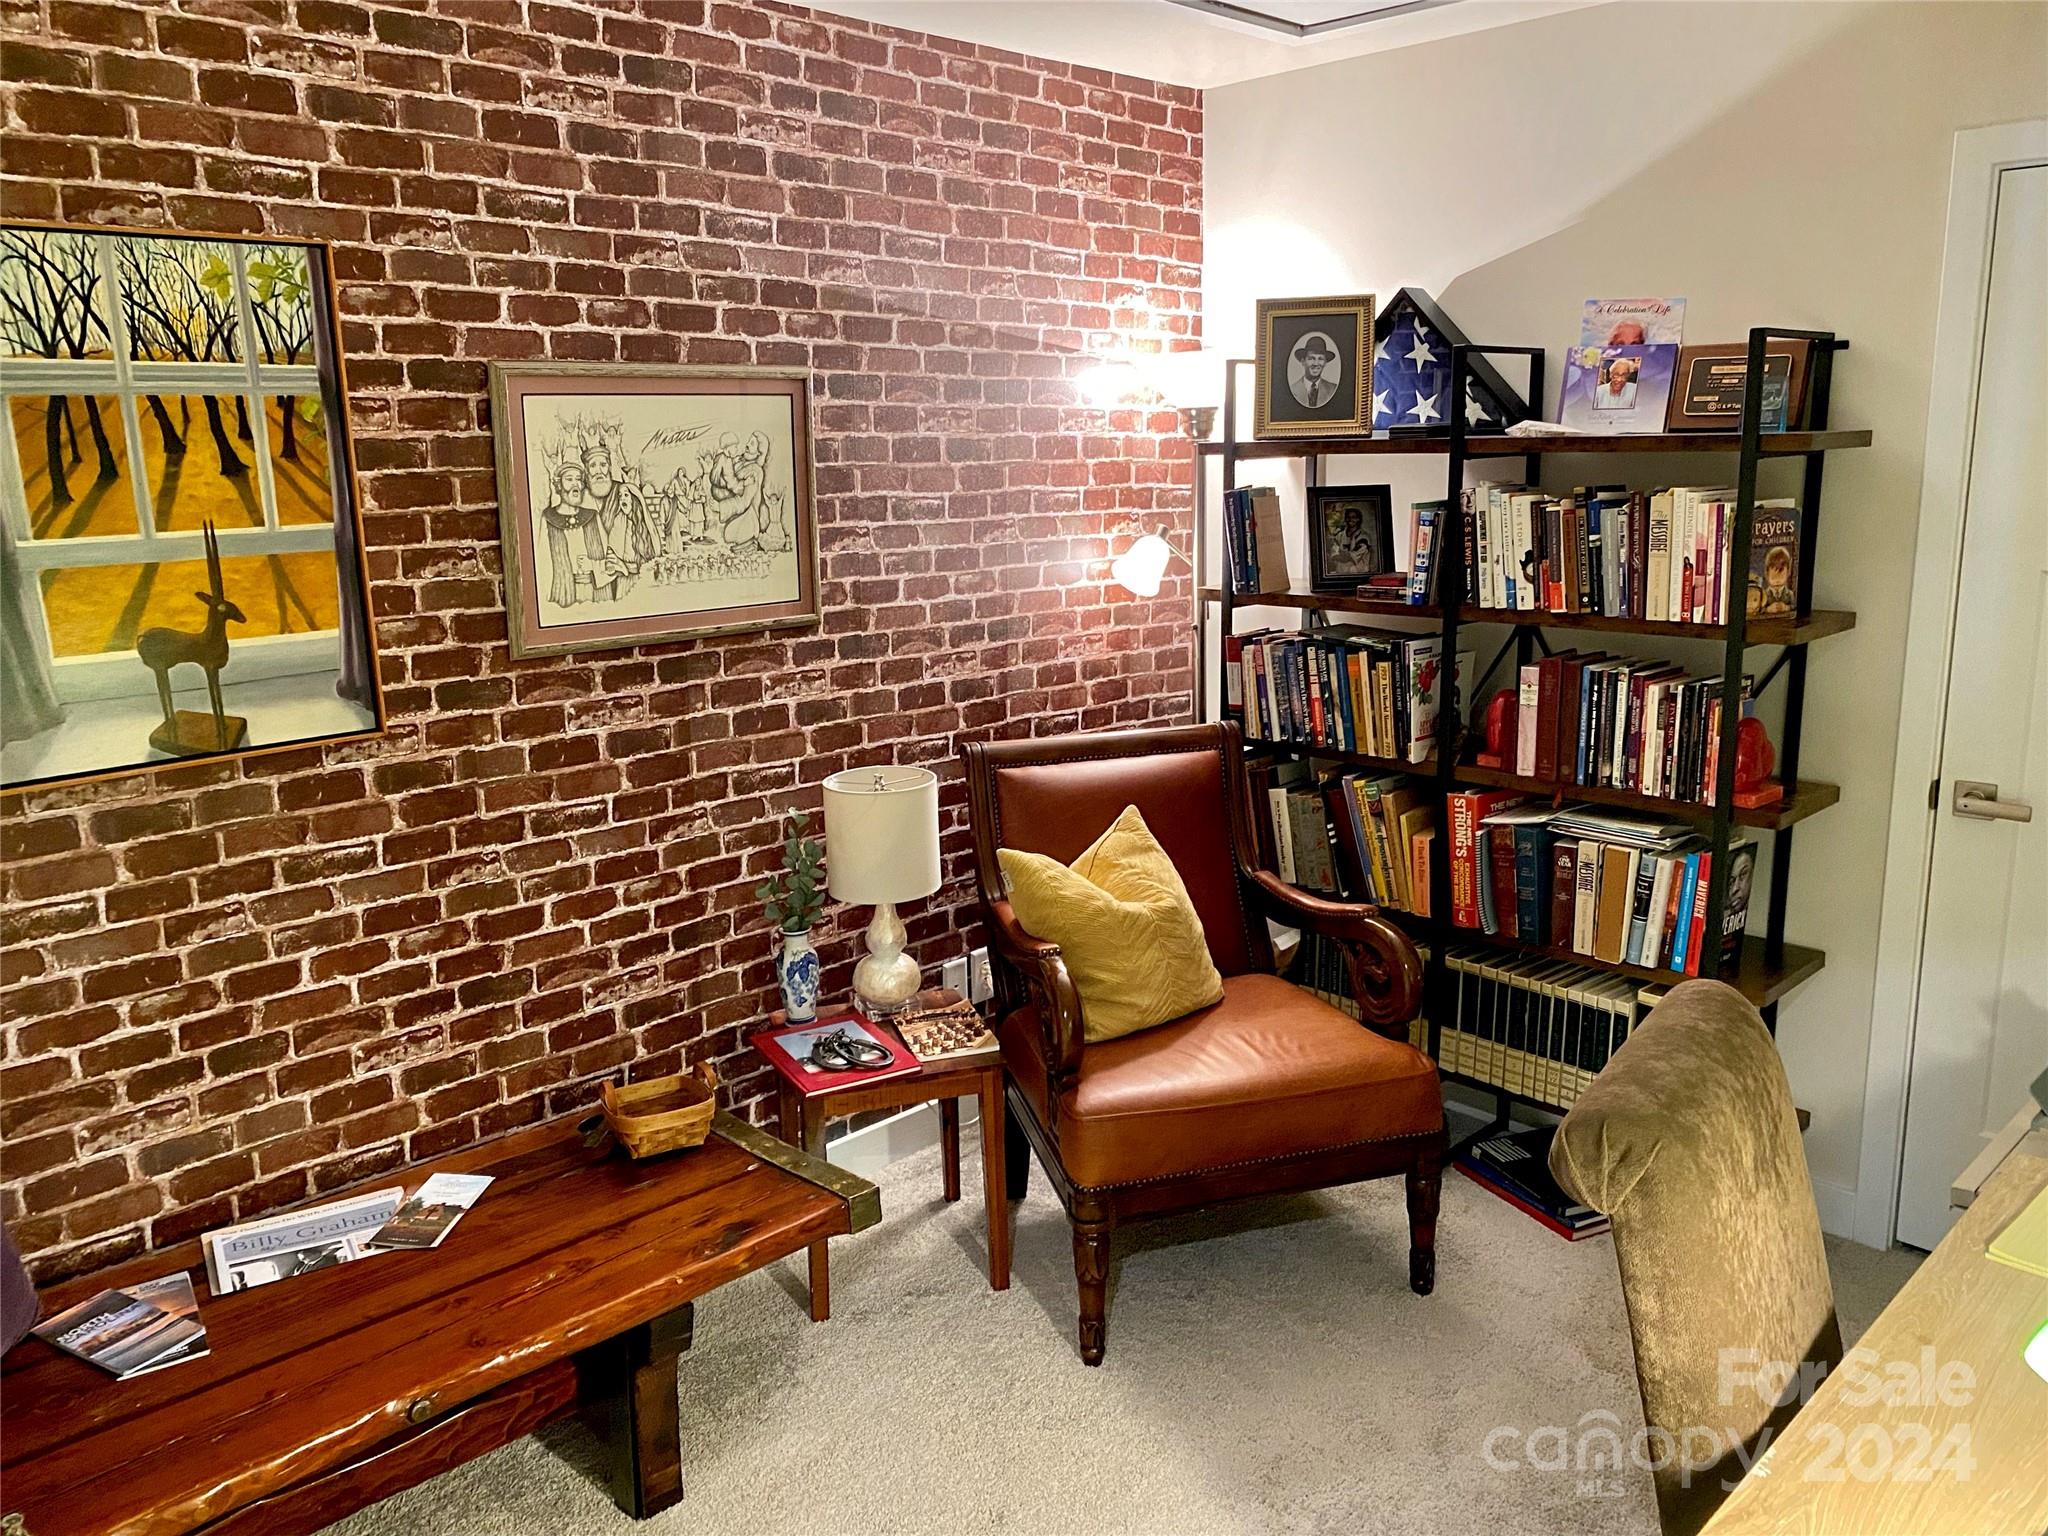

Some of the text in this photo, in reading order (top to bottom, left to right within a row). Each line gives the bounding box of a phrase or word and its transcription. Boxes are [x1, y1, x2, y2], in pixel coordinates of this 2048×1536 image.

[1606, 303, 1647, 315] Celebration
[1652, 303, 1672, 316] Life
[1686, 496, 1695, 540] SURRENDER
[1754, 520, 1795, 537] rayers
[1650, 519, 1668, 552] MESSAGE
[1464, 536, 1472, 566] LEWIS
[1580, 556, 1586, 564] OF
[1382, 695, 1390, 713] World
[1580, 702, 1588, 730] COMPLEX
[1668, 703, 1676, 726] FINAL
[1490, 801, 1506, 812] THE
[1454, 798, 1466, 857] STRONG'S
[1418, 846, 1426, 860] Back
[1453, 860, 1459, 870] OF
[1458, 858, 1466, 908] CONCORDANCE
[1578, 862, 1594, 893] MESSAGE
[1694, 880, 1708, 919] MAVERICK
[1722, 909, 1746, 936] ERICK
[233, 1210, 392, 1254] Billy Graham
[56, 1311, 112, 1345] NORTH
[63, 1301, 141, 1346] CAROLINA
